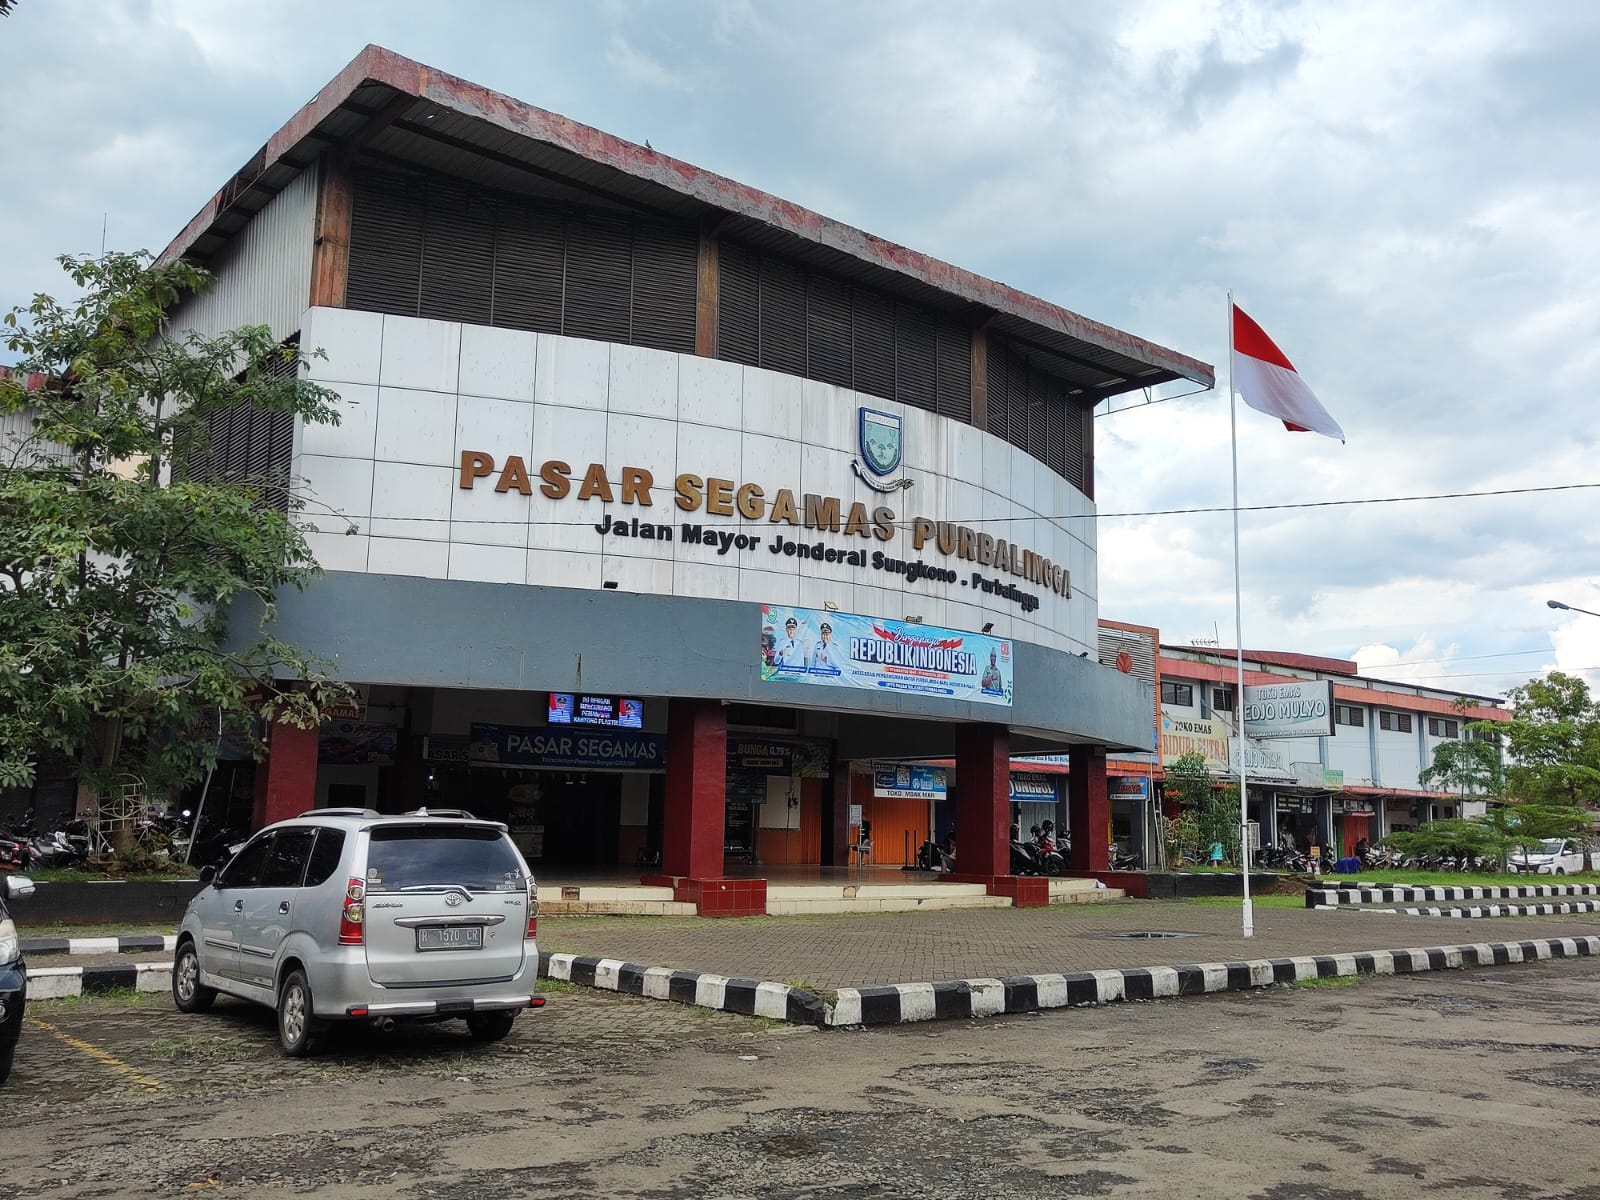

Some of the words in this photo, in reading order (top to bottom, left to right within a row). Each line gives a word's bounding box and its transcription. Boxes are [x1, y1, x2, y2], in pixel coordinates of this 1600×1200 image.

[460, 449, 654, 507] PASAR
[674, 473, 896, 541] SEGAMAS
[913, 516, 1072, 600] PURBALINGGA
[594, 514, 673, 541] Jalan
[681, 523, 761, 555] Mayor
[768, 535, 867, 567] Jenderal
[872, 550, 957, 583] Sungkono
[972, 572, 1040, 612] Purbalingga
[850, 637, 915, 670] REPUBLIK
[914, 645, 977, 675] INDONESIA
[1257, 687, 1278, 701] TOKO
[1279, 686, 1302, 699] EMAS
[1279, 699, 1326, 719] MULYO
[1175, 721, 1193, 733] TOKO
[1194, 723, 1212, 735] EMAS
[507, 734, 572, 756] PASAR
[577, 737, 657, 760] SEGAMAS
[737, 743, 769, 756] BUNGA
[421, 930, 428, 942] R
[466, 929, 478, 941] CR
